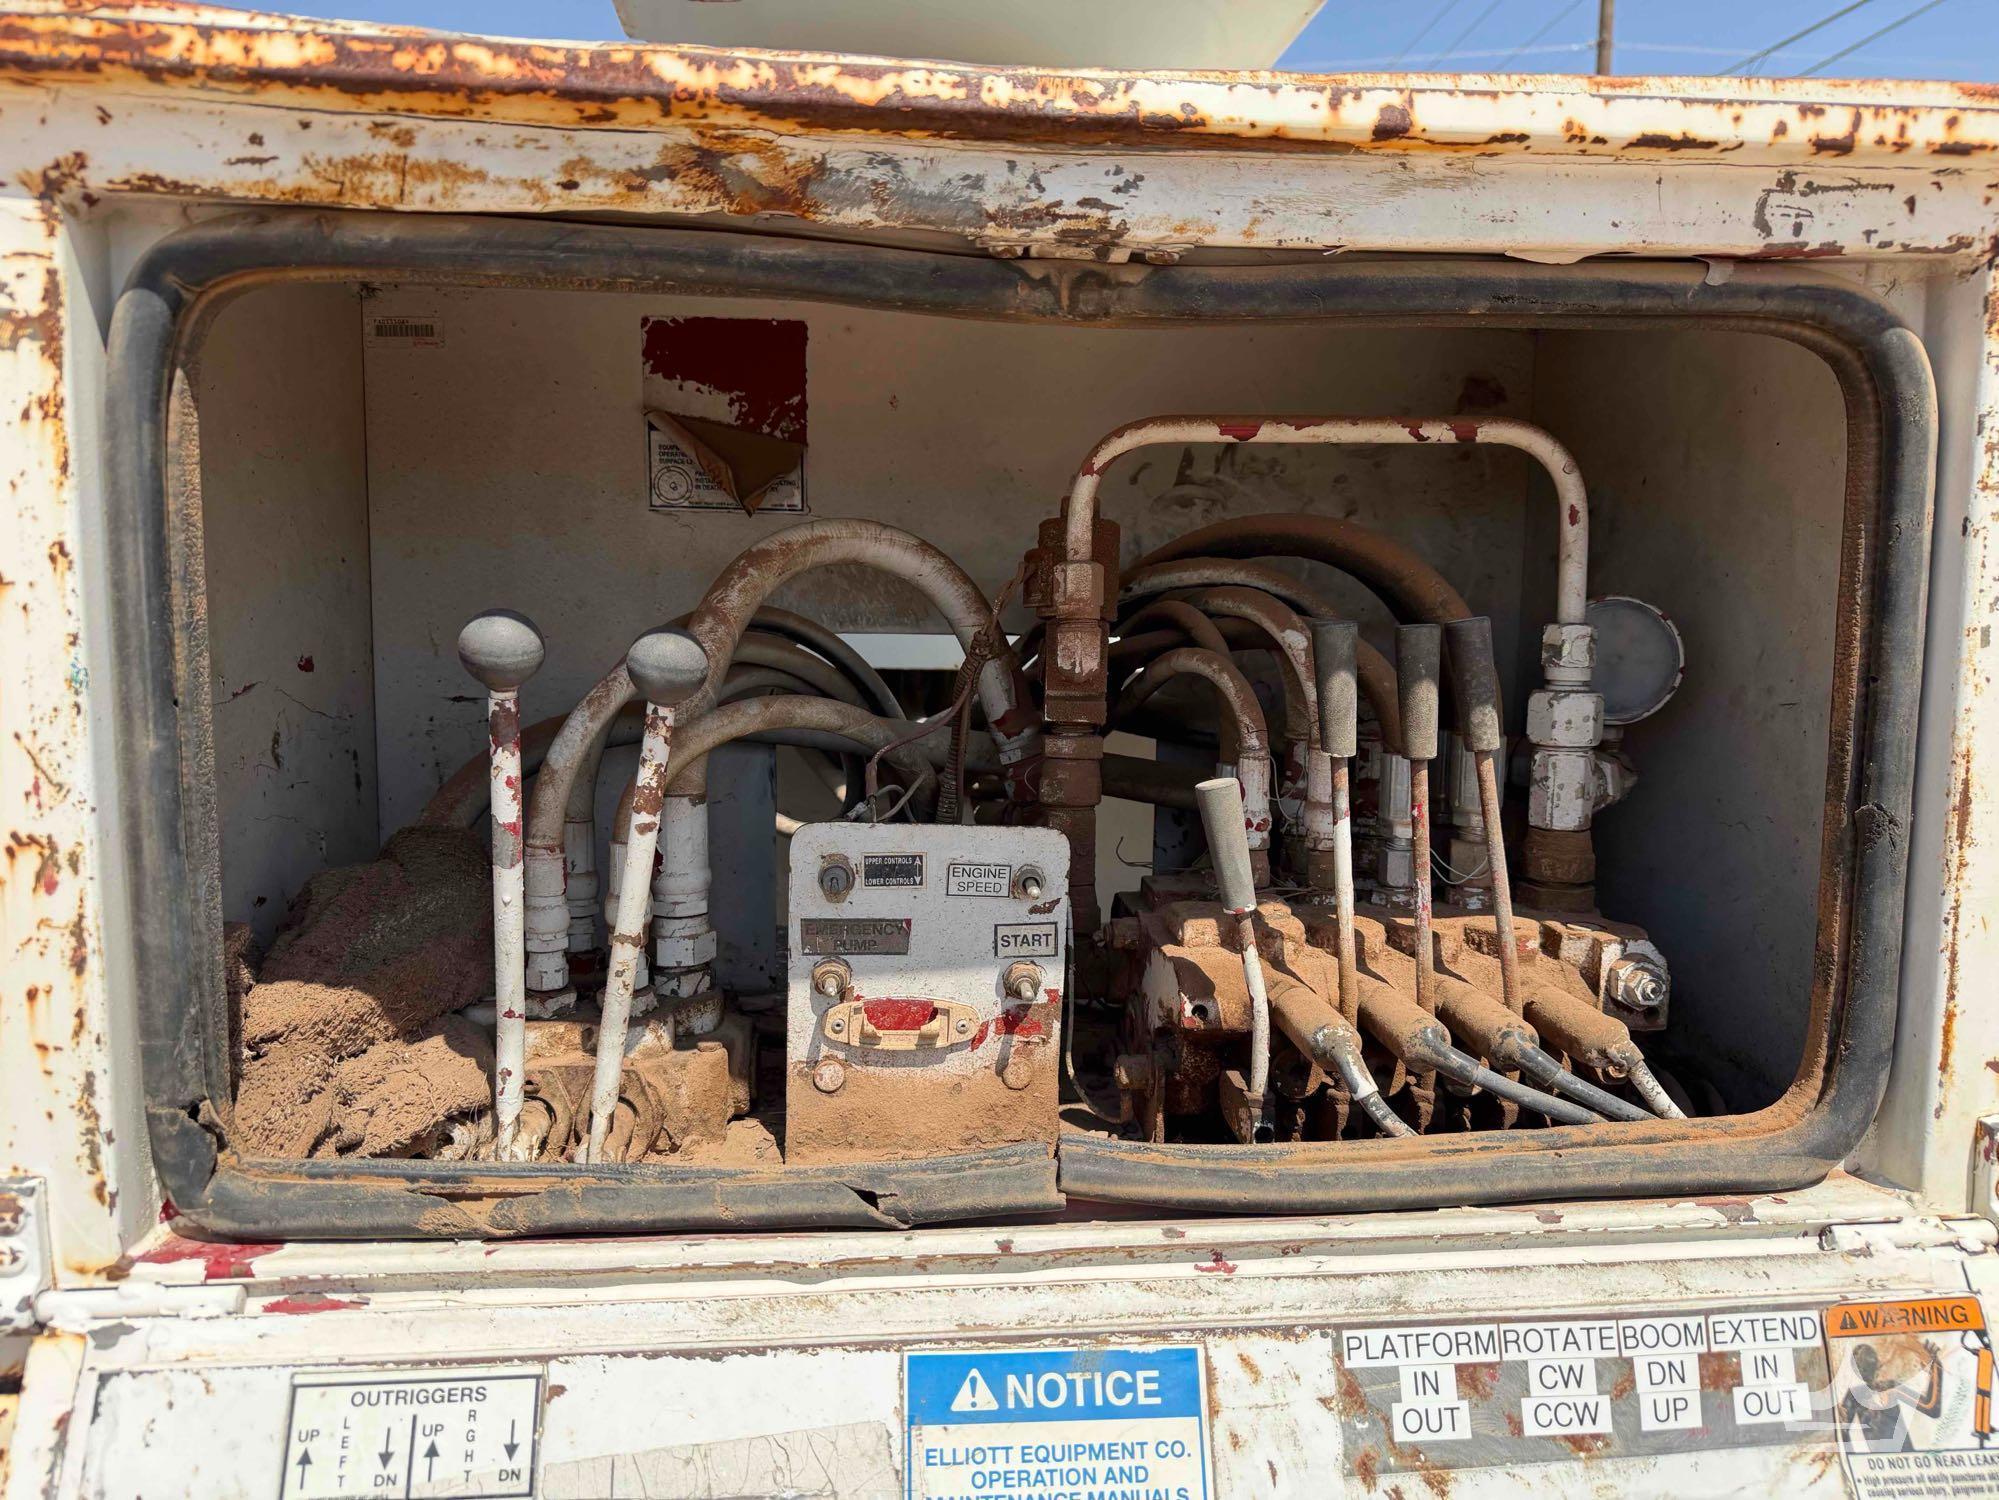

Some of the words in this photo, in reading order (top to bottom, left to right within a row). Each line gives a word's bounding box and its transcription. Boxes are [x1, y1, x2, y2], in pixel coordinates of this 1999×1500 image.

[864, 857, 883, 865] UPPER
[883, 856, 912, 865] CONTROLS
[952, 866, 1007, 879] ENGINE
[865, 877, 885, 886] LOWER
[885, 877, 914, 886] CONTROLS
[957, 882, 1002, 893] SPEED
[805, 923, 903, 936] EMERGENCY
[1000, 933, 1053, 948] START
[834, 939, 877, 951] PUMP
[1858, 1304, 1969, 1329] WARNING
[1503, 1326, 1616, 1353] ROTATE
[1622, 1321, 1705, 1350] BOOM
[1712, 1316, 1818, 1345] EXTEND
[1346, 1329, 1497, 1361] PLATFORM
[1539, 1364, 1584, 1390] CW
[1648, 1360, 1687, 1386] DN
[1754, 1353, 1779, 1379] IN
[1006, 1370, 1162, 1409] NOTICE
[1413, 1370, 1440, 1396] IN
[351, 1386, 488, 1407] OUTRIGGERS
[1743, 1389, 1798, 1416] OUT
[1402, 1406, 1460, 1434] OUT
[1534, 1401, 1600, 1428] CCW
[1653, 1397, 1689, 1423] UP
[298, 1429, 320, 1443] UP
[422, 1424, 445, 1437] UP
[336, 1416, 351, 1488] LEFT
[925, 1446, 1014, 1466] ELLIOTT
[1021, 1441, 1149, 1463] EQUIPMENT
[1155, 1440, 1192, 1459] CO.
[1867, 1457, 1885, 1470] DO
[1887, 1456, 1911, 1470] NOT
[1914, 1456, 1931, 1468] GO
[1934, 1454, 1966, 1467] NEAR
[373, 1474, 398, 1487] DN
[498, 1468, 522, 1482] DN
[971, 1466, 1097, 1489] OPERATION
[1103, 1465, 1149, 1485] AND
